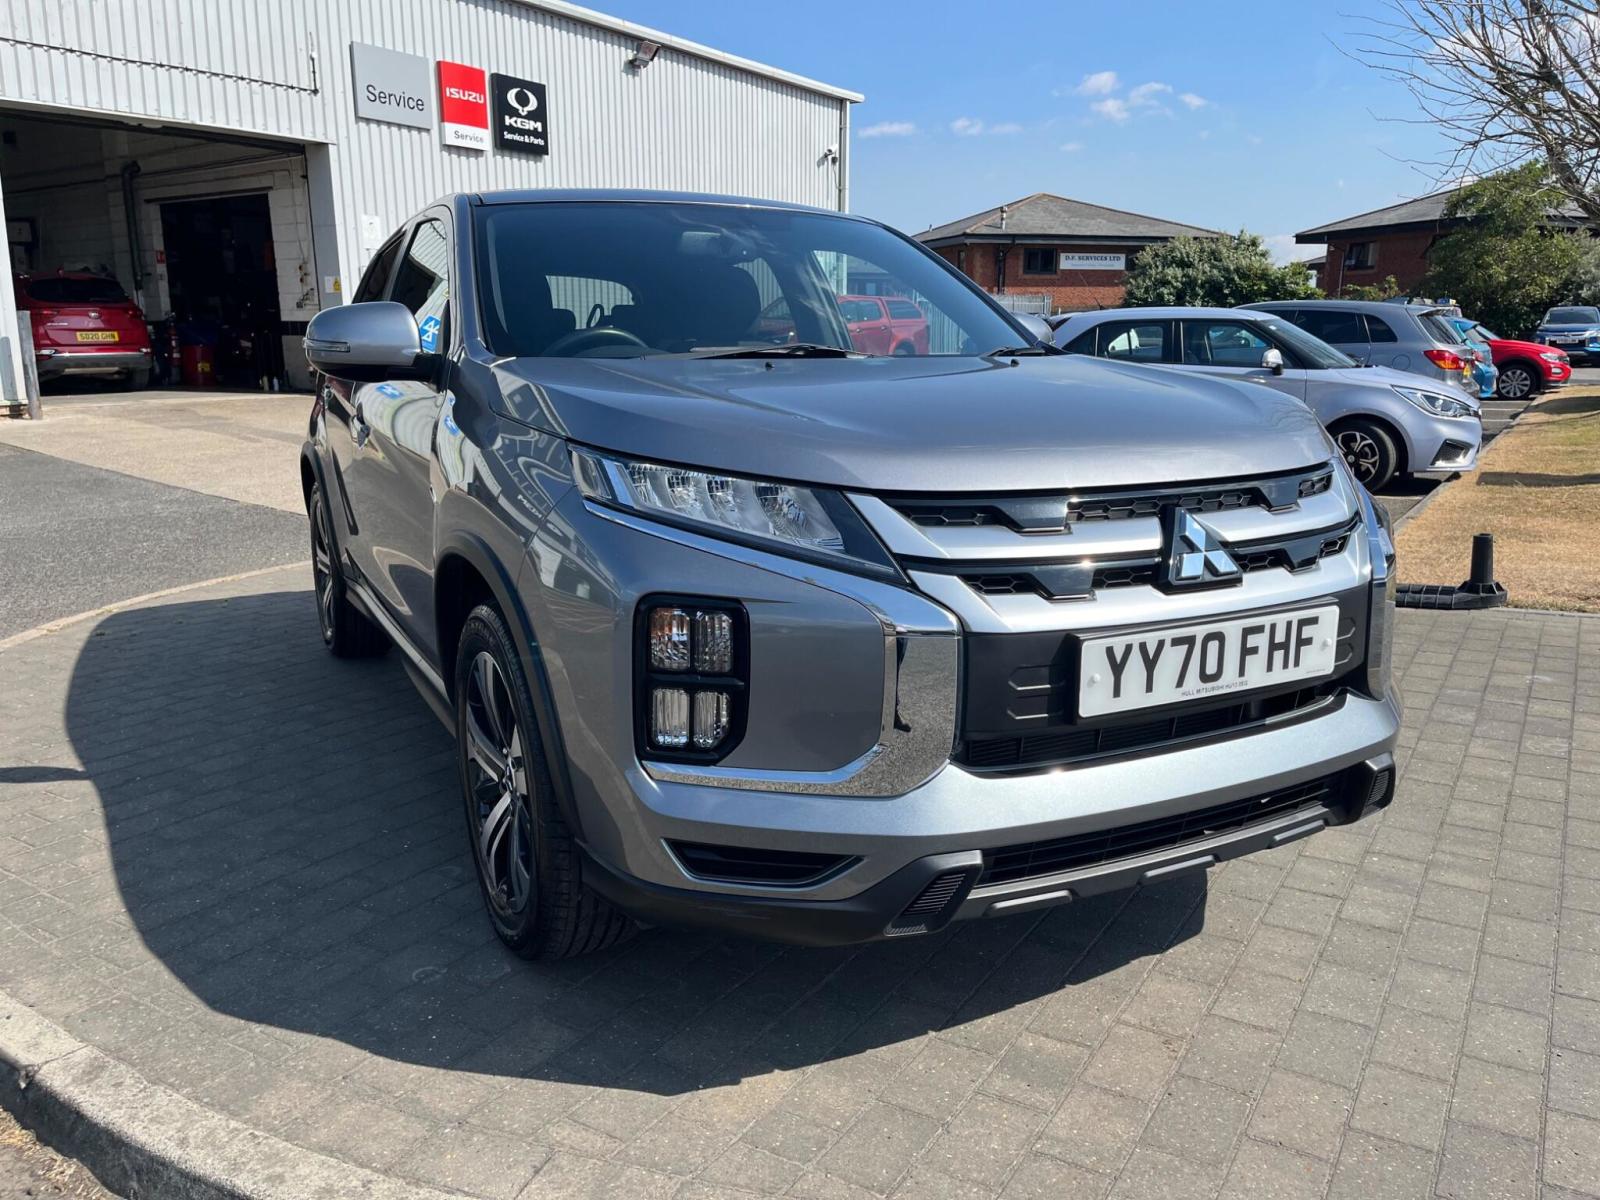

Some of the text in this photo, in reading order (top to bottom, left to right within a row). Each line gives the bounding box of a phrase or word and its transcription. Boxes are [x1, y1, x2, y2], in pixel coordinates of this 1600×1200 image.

[365, 84, 425, 111] Service
[445, 86, 484, 104] ISUZU
[504, 115, 543, 132] KGM
[454, 129, 484, 144] Service
[503, 131, 545, 146] Service & Parts
[1105, 615, 1320, 699] YY70 FHF
